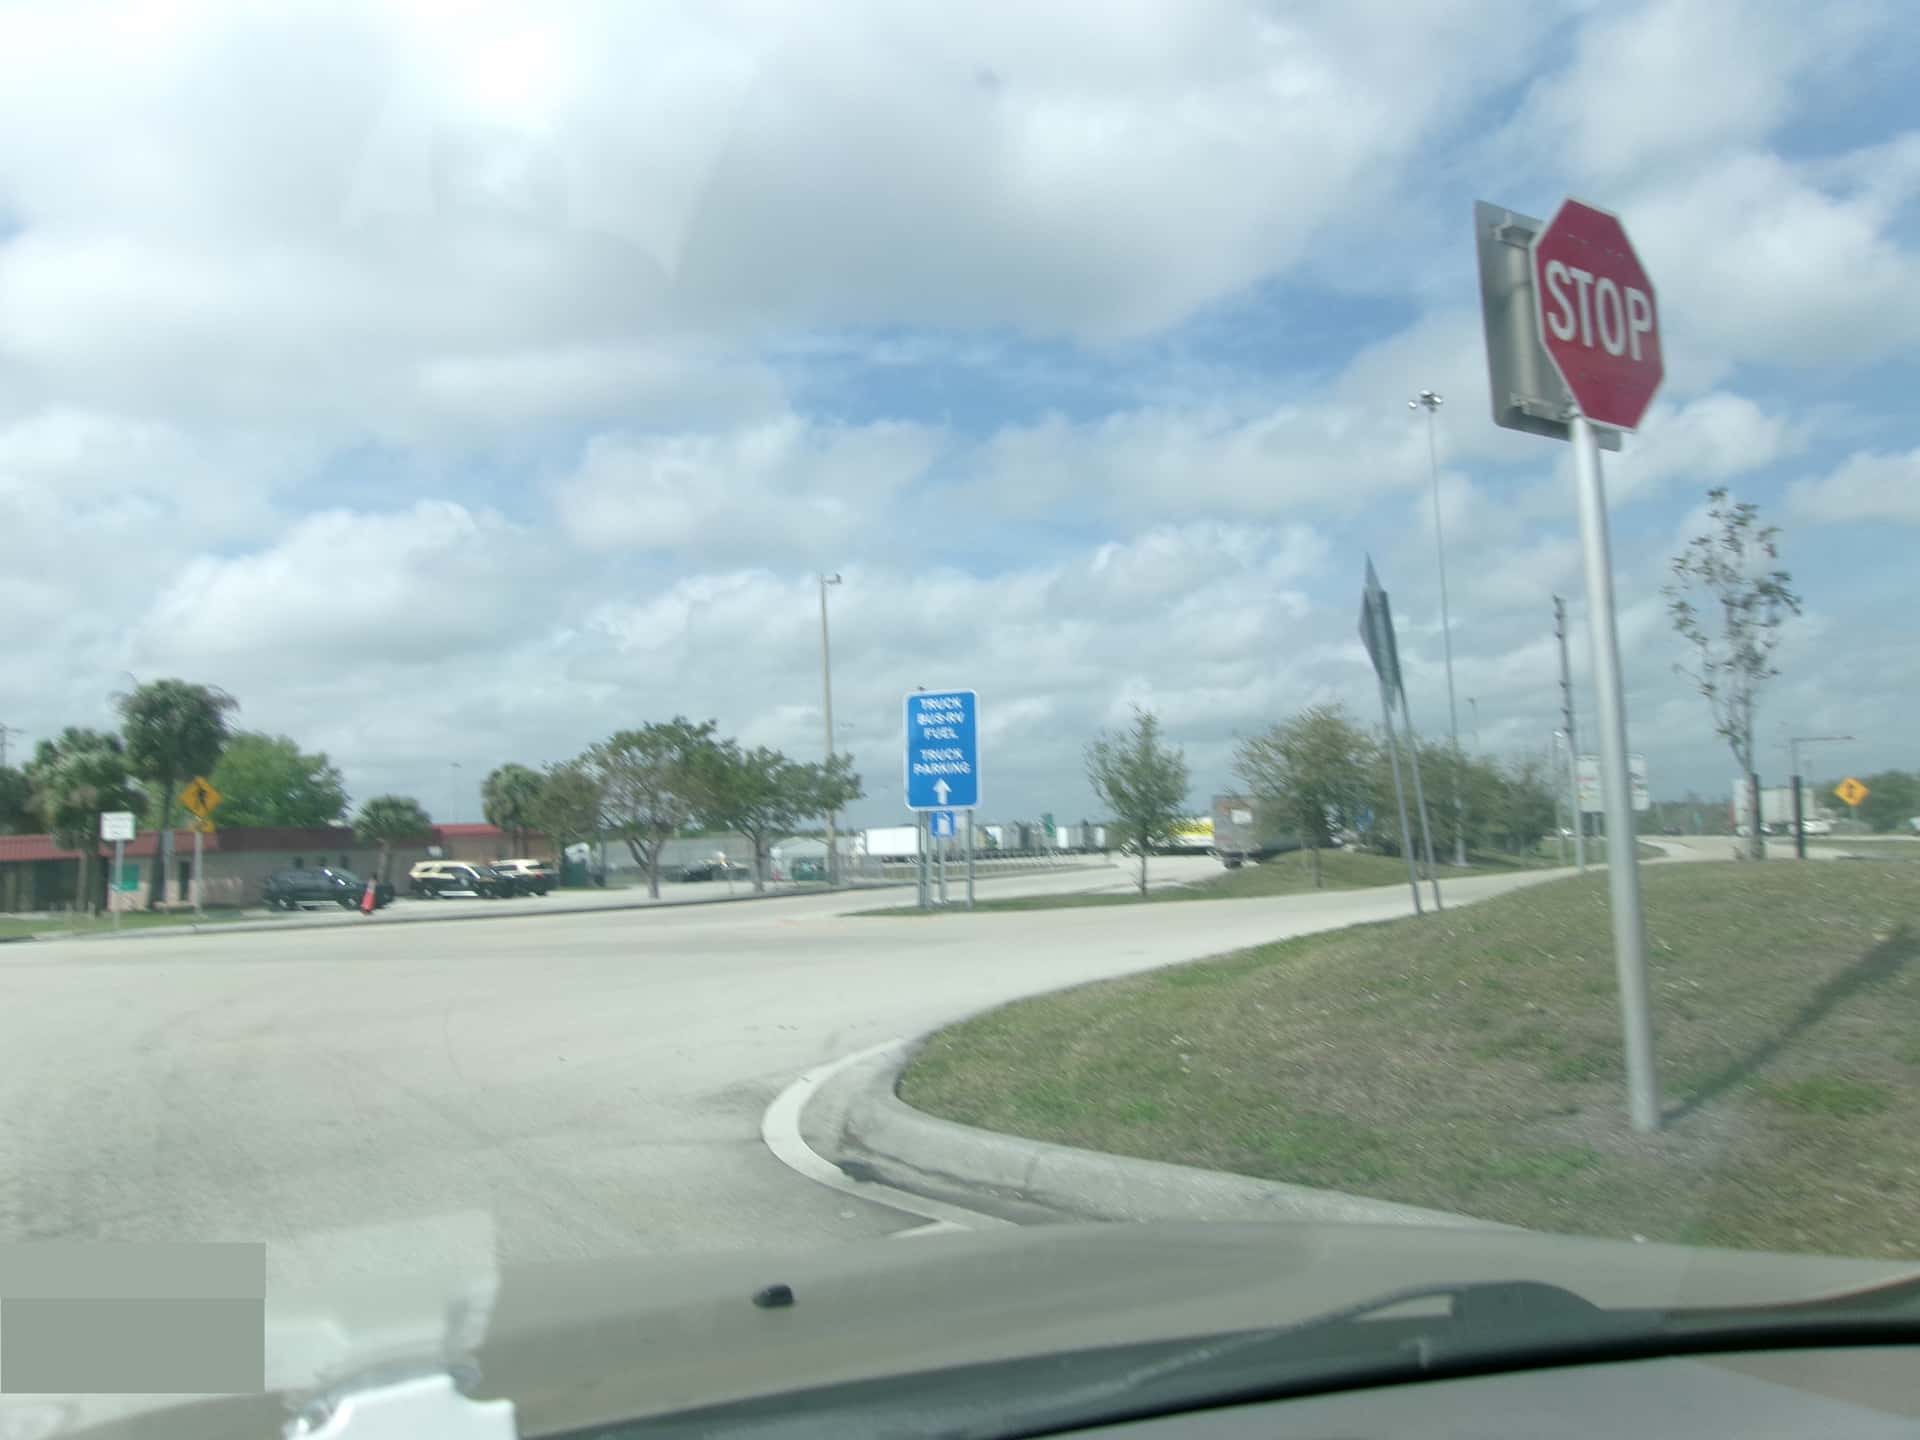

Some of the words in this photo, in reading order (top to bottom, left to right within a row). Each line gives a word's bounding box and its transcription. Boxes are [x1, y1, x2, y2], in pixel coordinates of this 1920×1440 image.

[1545, 260, 1651, 361] STOP
[919, 697, 963, 710] TRUCK
[923, 726, 959, 740] FUEL
[919, 748, 963, 761] TRUCK
[912, 761, 971, 775] PARKING
